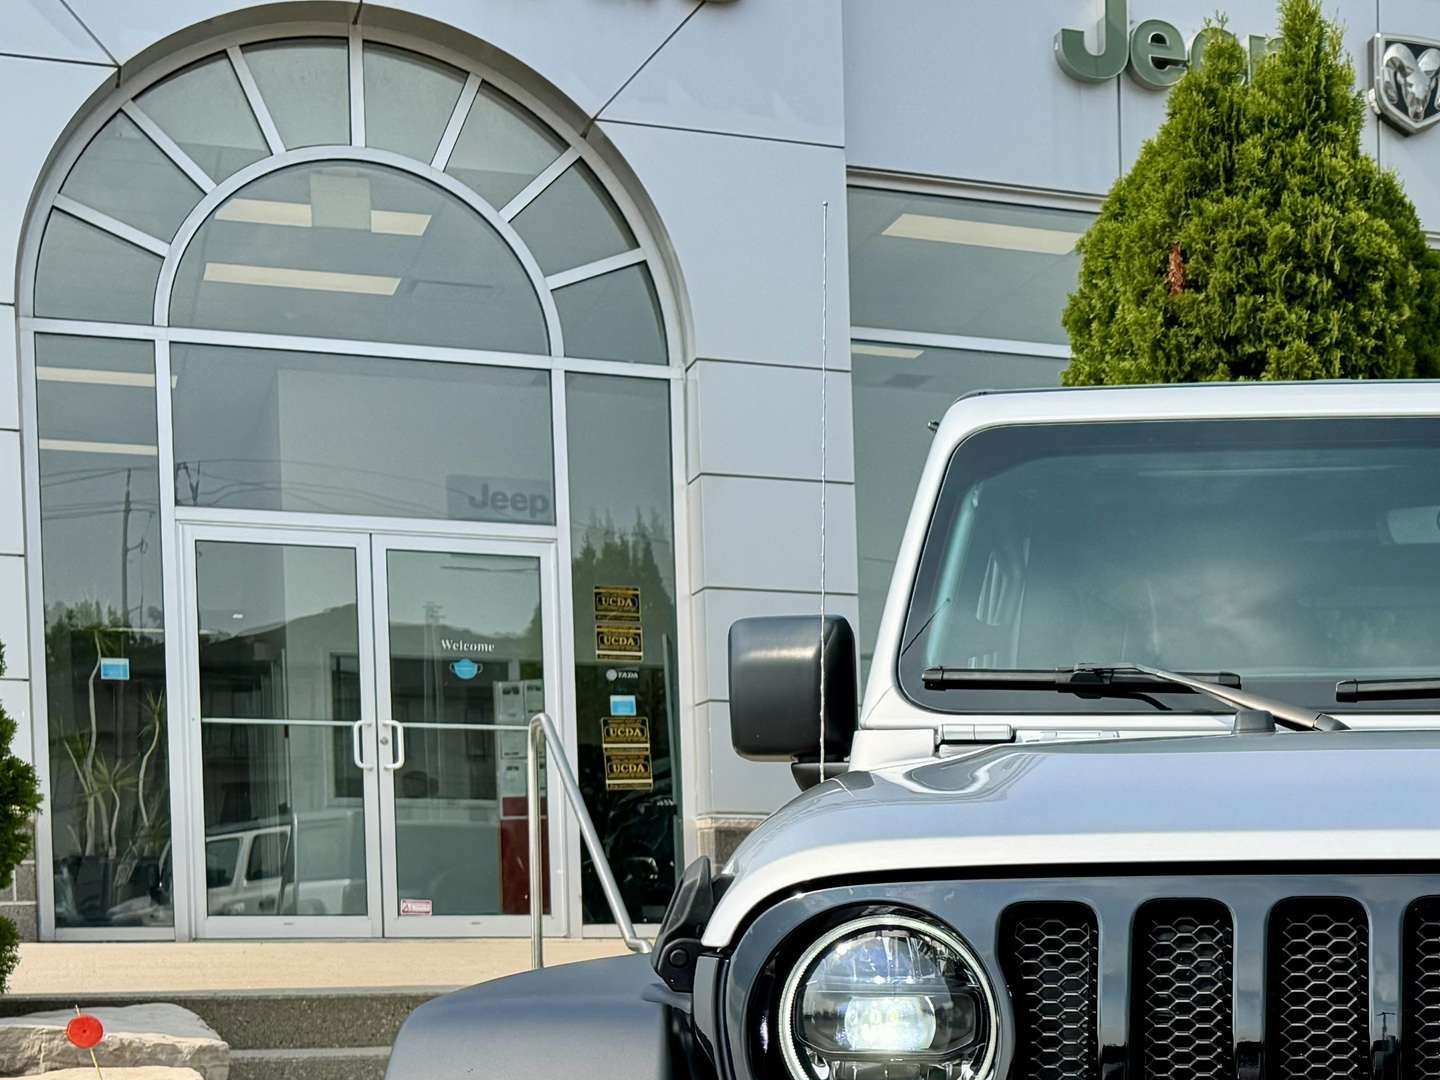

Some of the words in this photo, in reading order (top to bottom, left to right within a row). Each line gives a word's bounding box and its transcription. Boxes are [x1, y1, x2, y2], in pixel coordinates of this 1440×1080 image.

[468, 483, 549, 519] Jeep
[601, 597, 633, 608] UCDA
[441, 639, 495, 652] Welcome
[603, 636, 635, 647] UCDA
[610, 728, 642, 738] UCDA
[613, 764, 645, 774] UCDA
